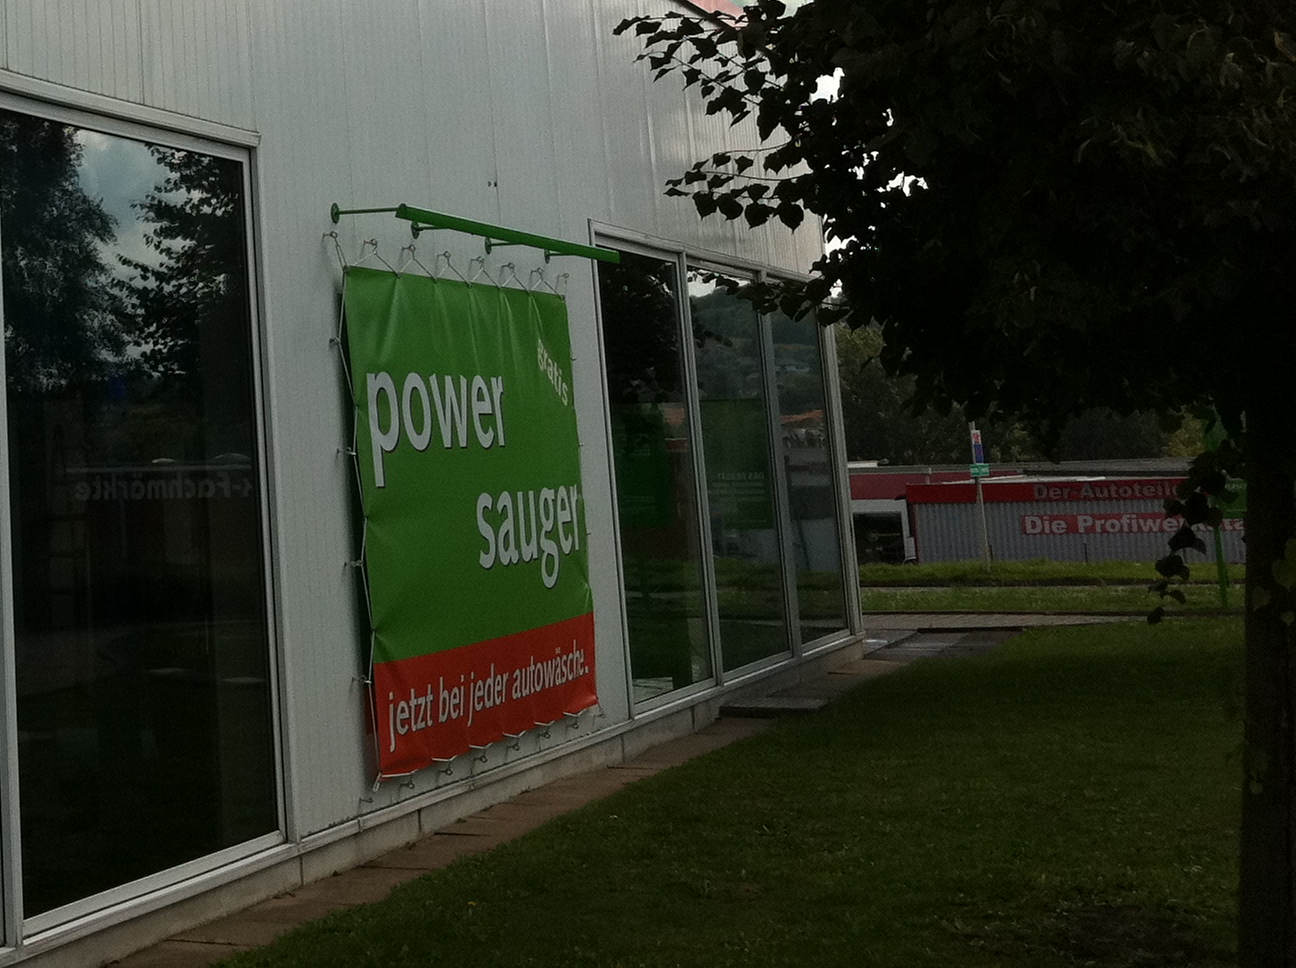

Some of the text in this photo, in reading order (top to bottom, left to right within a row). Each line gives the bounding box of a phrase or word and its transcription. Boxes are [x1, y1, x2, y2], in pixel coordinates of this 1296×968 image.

[537, 339, 568, 406] gratis
[366, 371, 505, 488] power
[476, 484, 580, 588] sauger
[1025, 515, 1068, 533] Die
[388, 638, 589, 752] jetzt bei jeder autowäsche.
